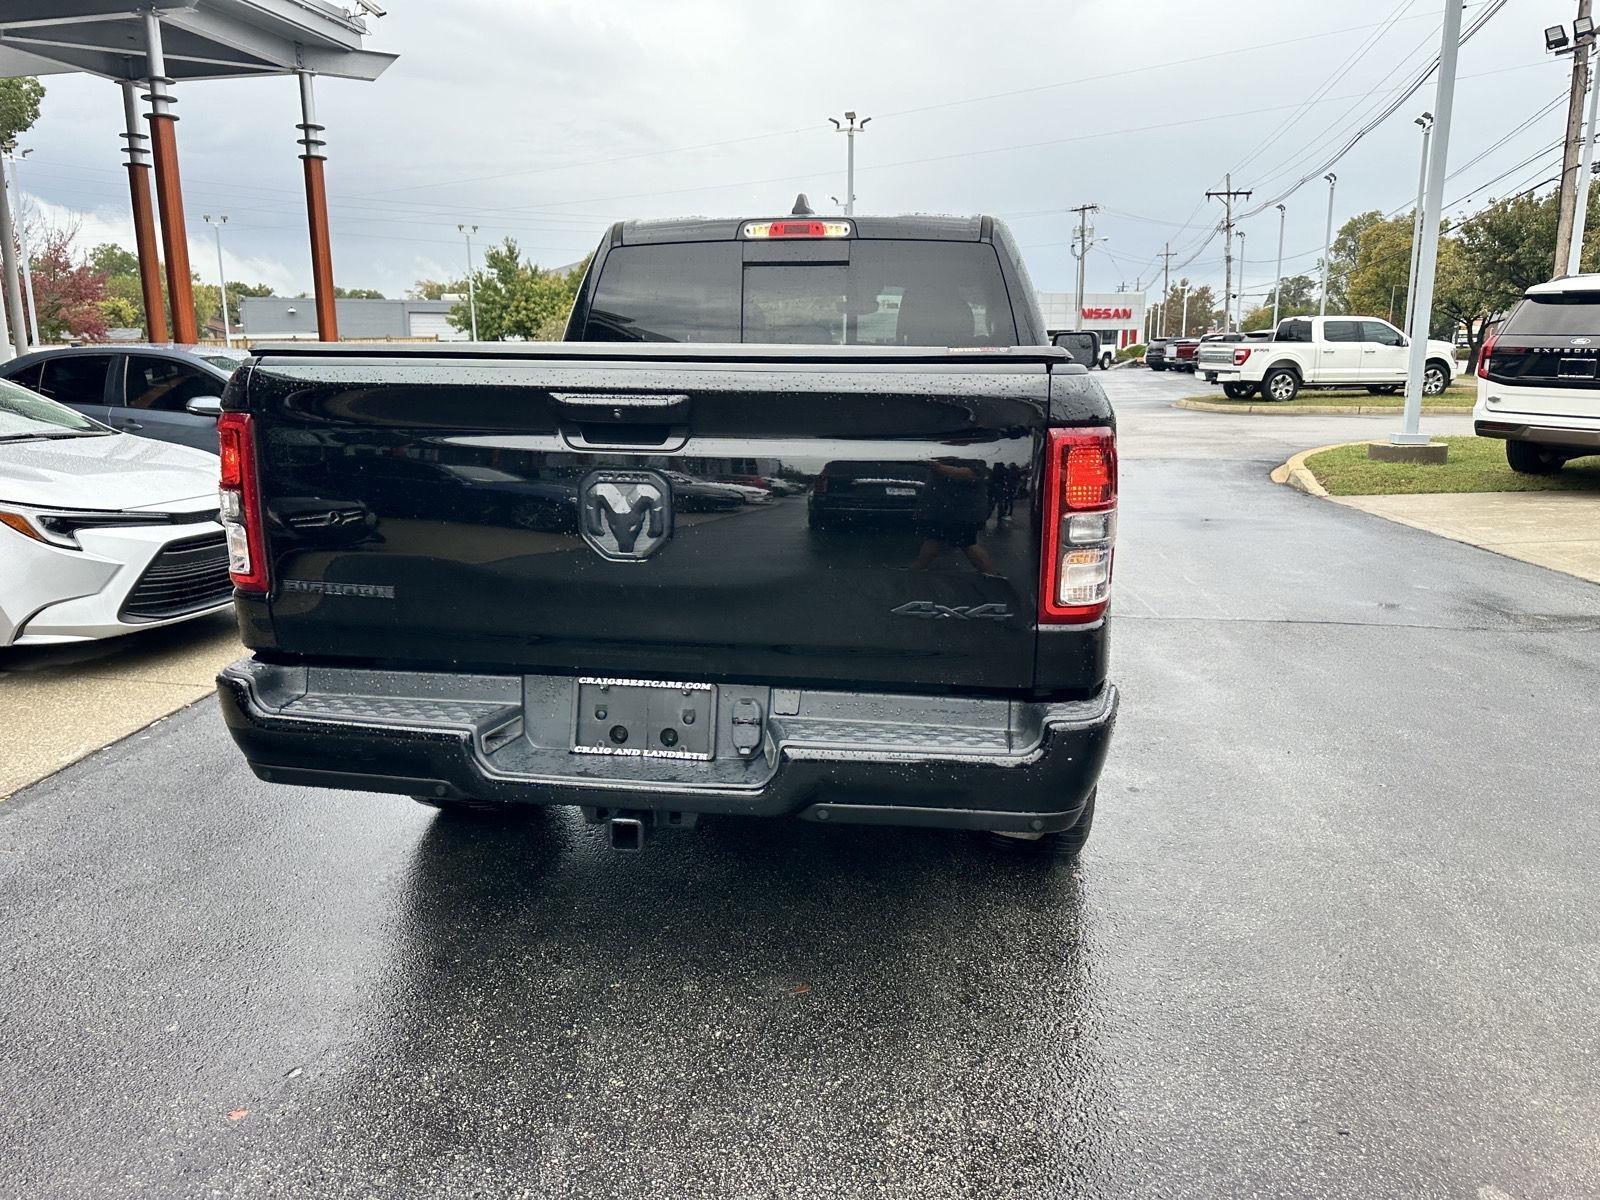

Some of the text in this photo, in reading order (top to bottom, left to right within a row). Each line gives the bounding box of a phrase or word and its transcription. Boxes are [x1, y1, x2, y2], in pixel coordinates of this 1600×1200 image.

[1081, 308, 1132, 319] NISSAN
[578, 677, 712, 690] CRAIGSBESTCARS.COM
[574, 746, 708, 760] CRAIG AND LANDRETH
